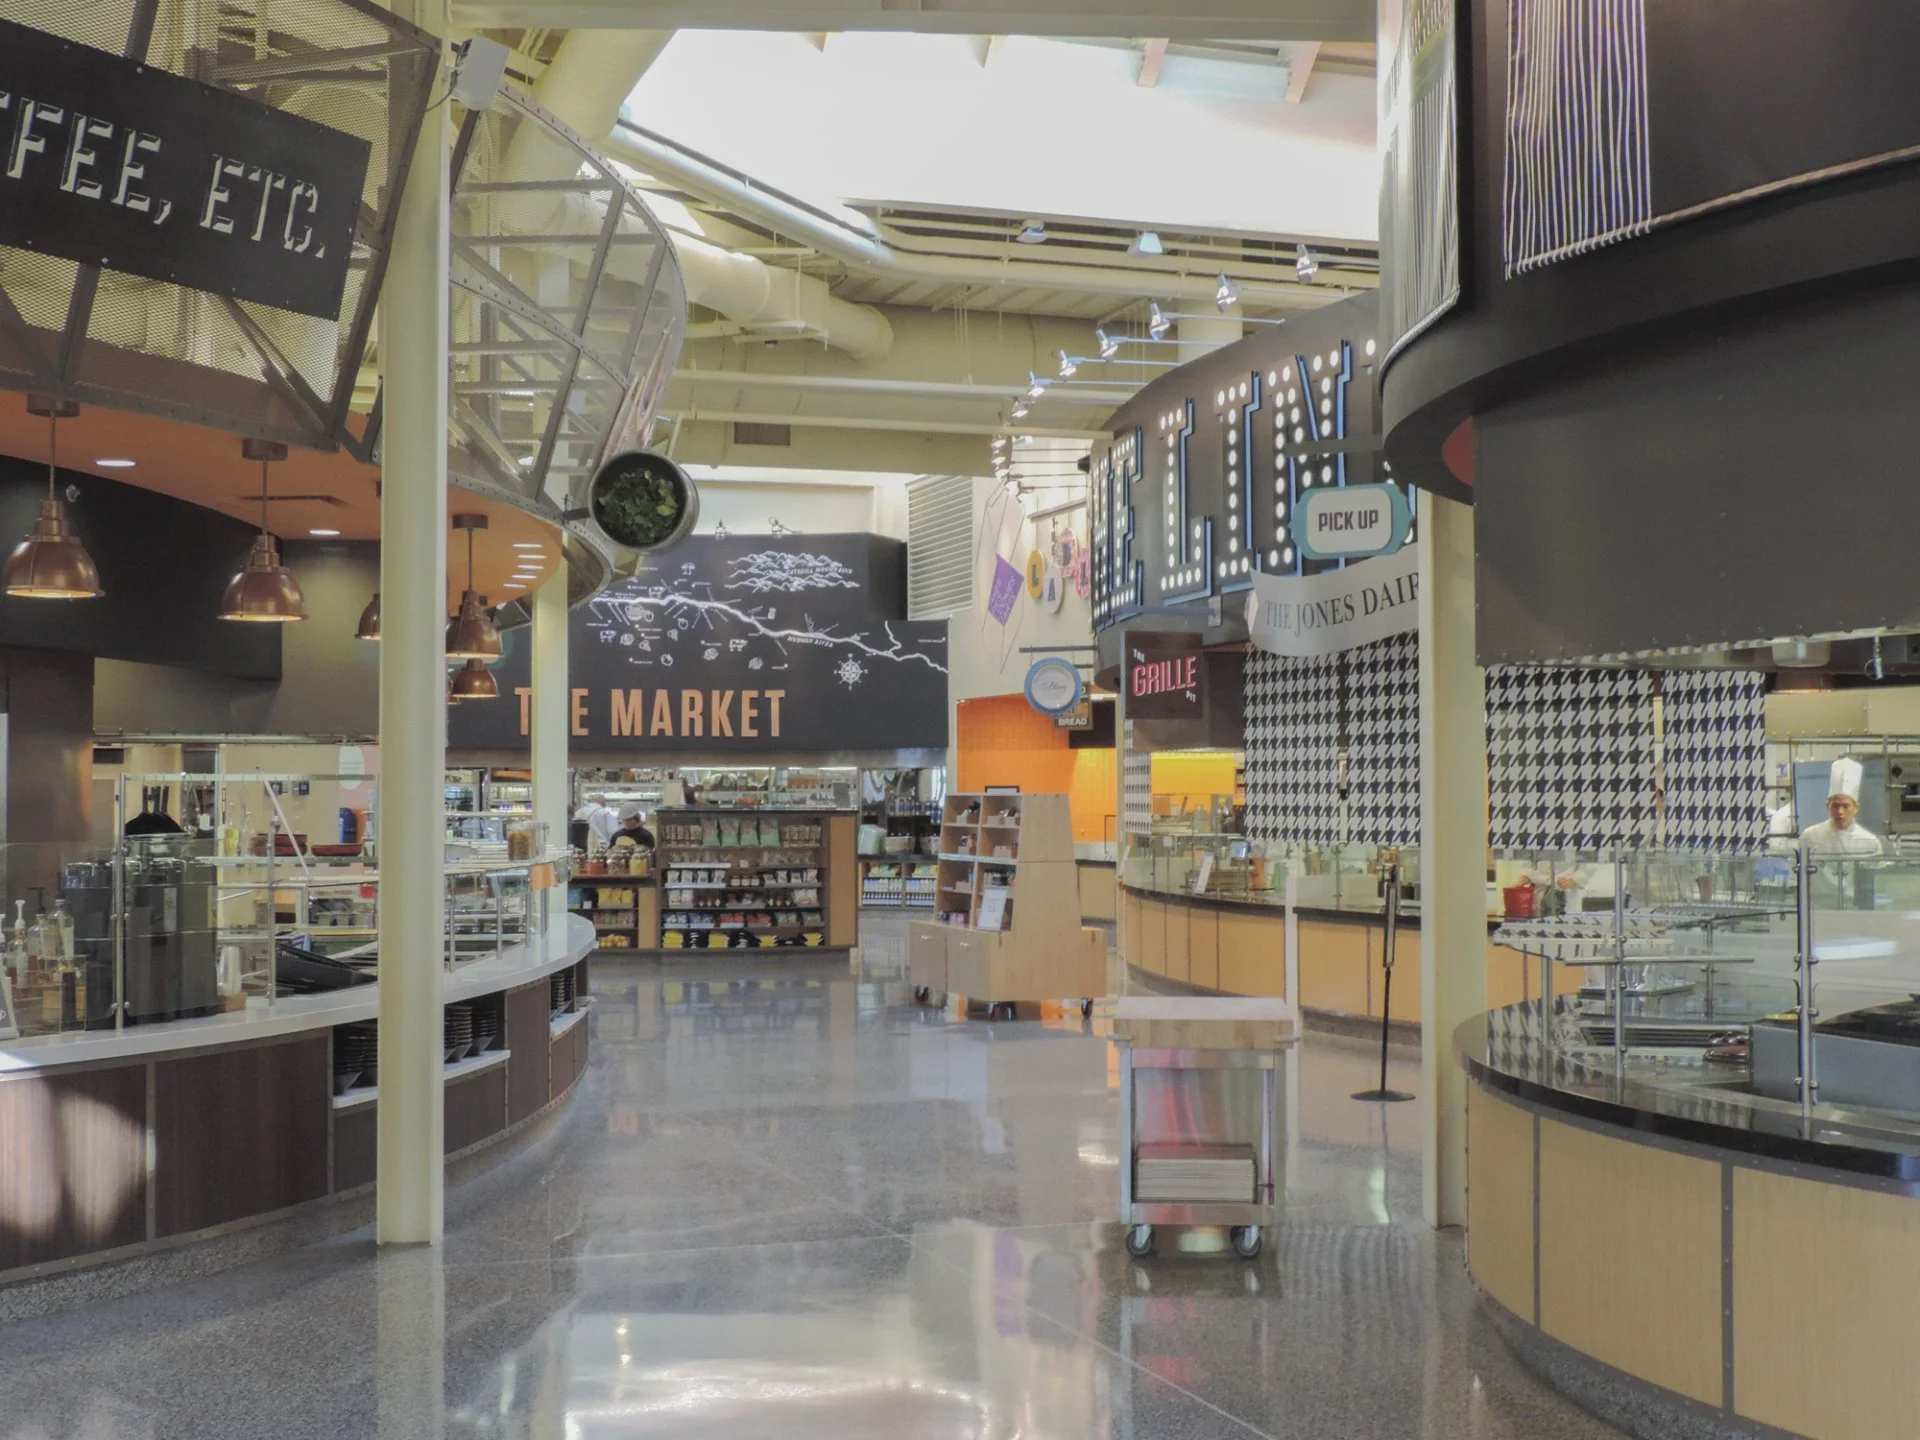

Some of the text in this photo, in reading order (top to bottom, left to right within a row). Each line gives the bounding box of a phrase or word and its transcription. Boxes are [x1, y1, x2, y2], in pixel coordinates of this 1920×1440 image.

[0, 91, 326, 259] FEE, ETC.
[1318, 509, 1379, 532] PICK UP
[1264, 599, 1293, 630] THE
[1293, 593, 1356, 637] JONES
[1131, 655, 1197, 697] GRILLE
[1132, 648, 1145, 663] THE
[513, 686, 786, 738] TE MARKET
[1058, 717, 1087, 727] BREAD
